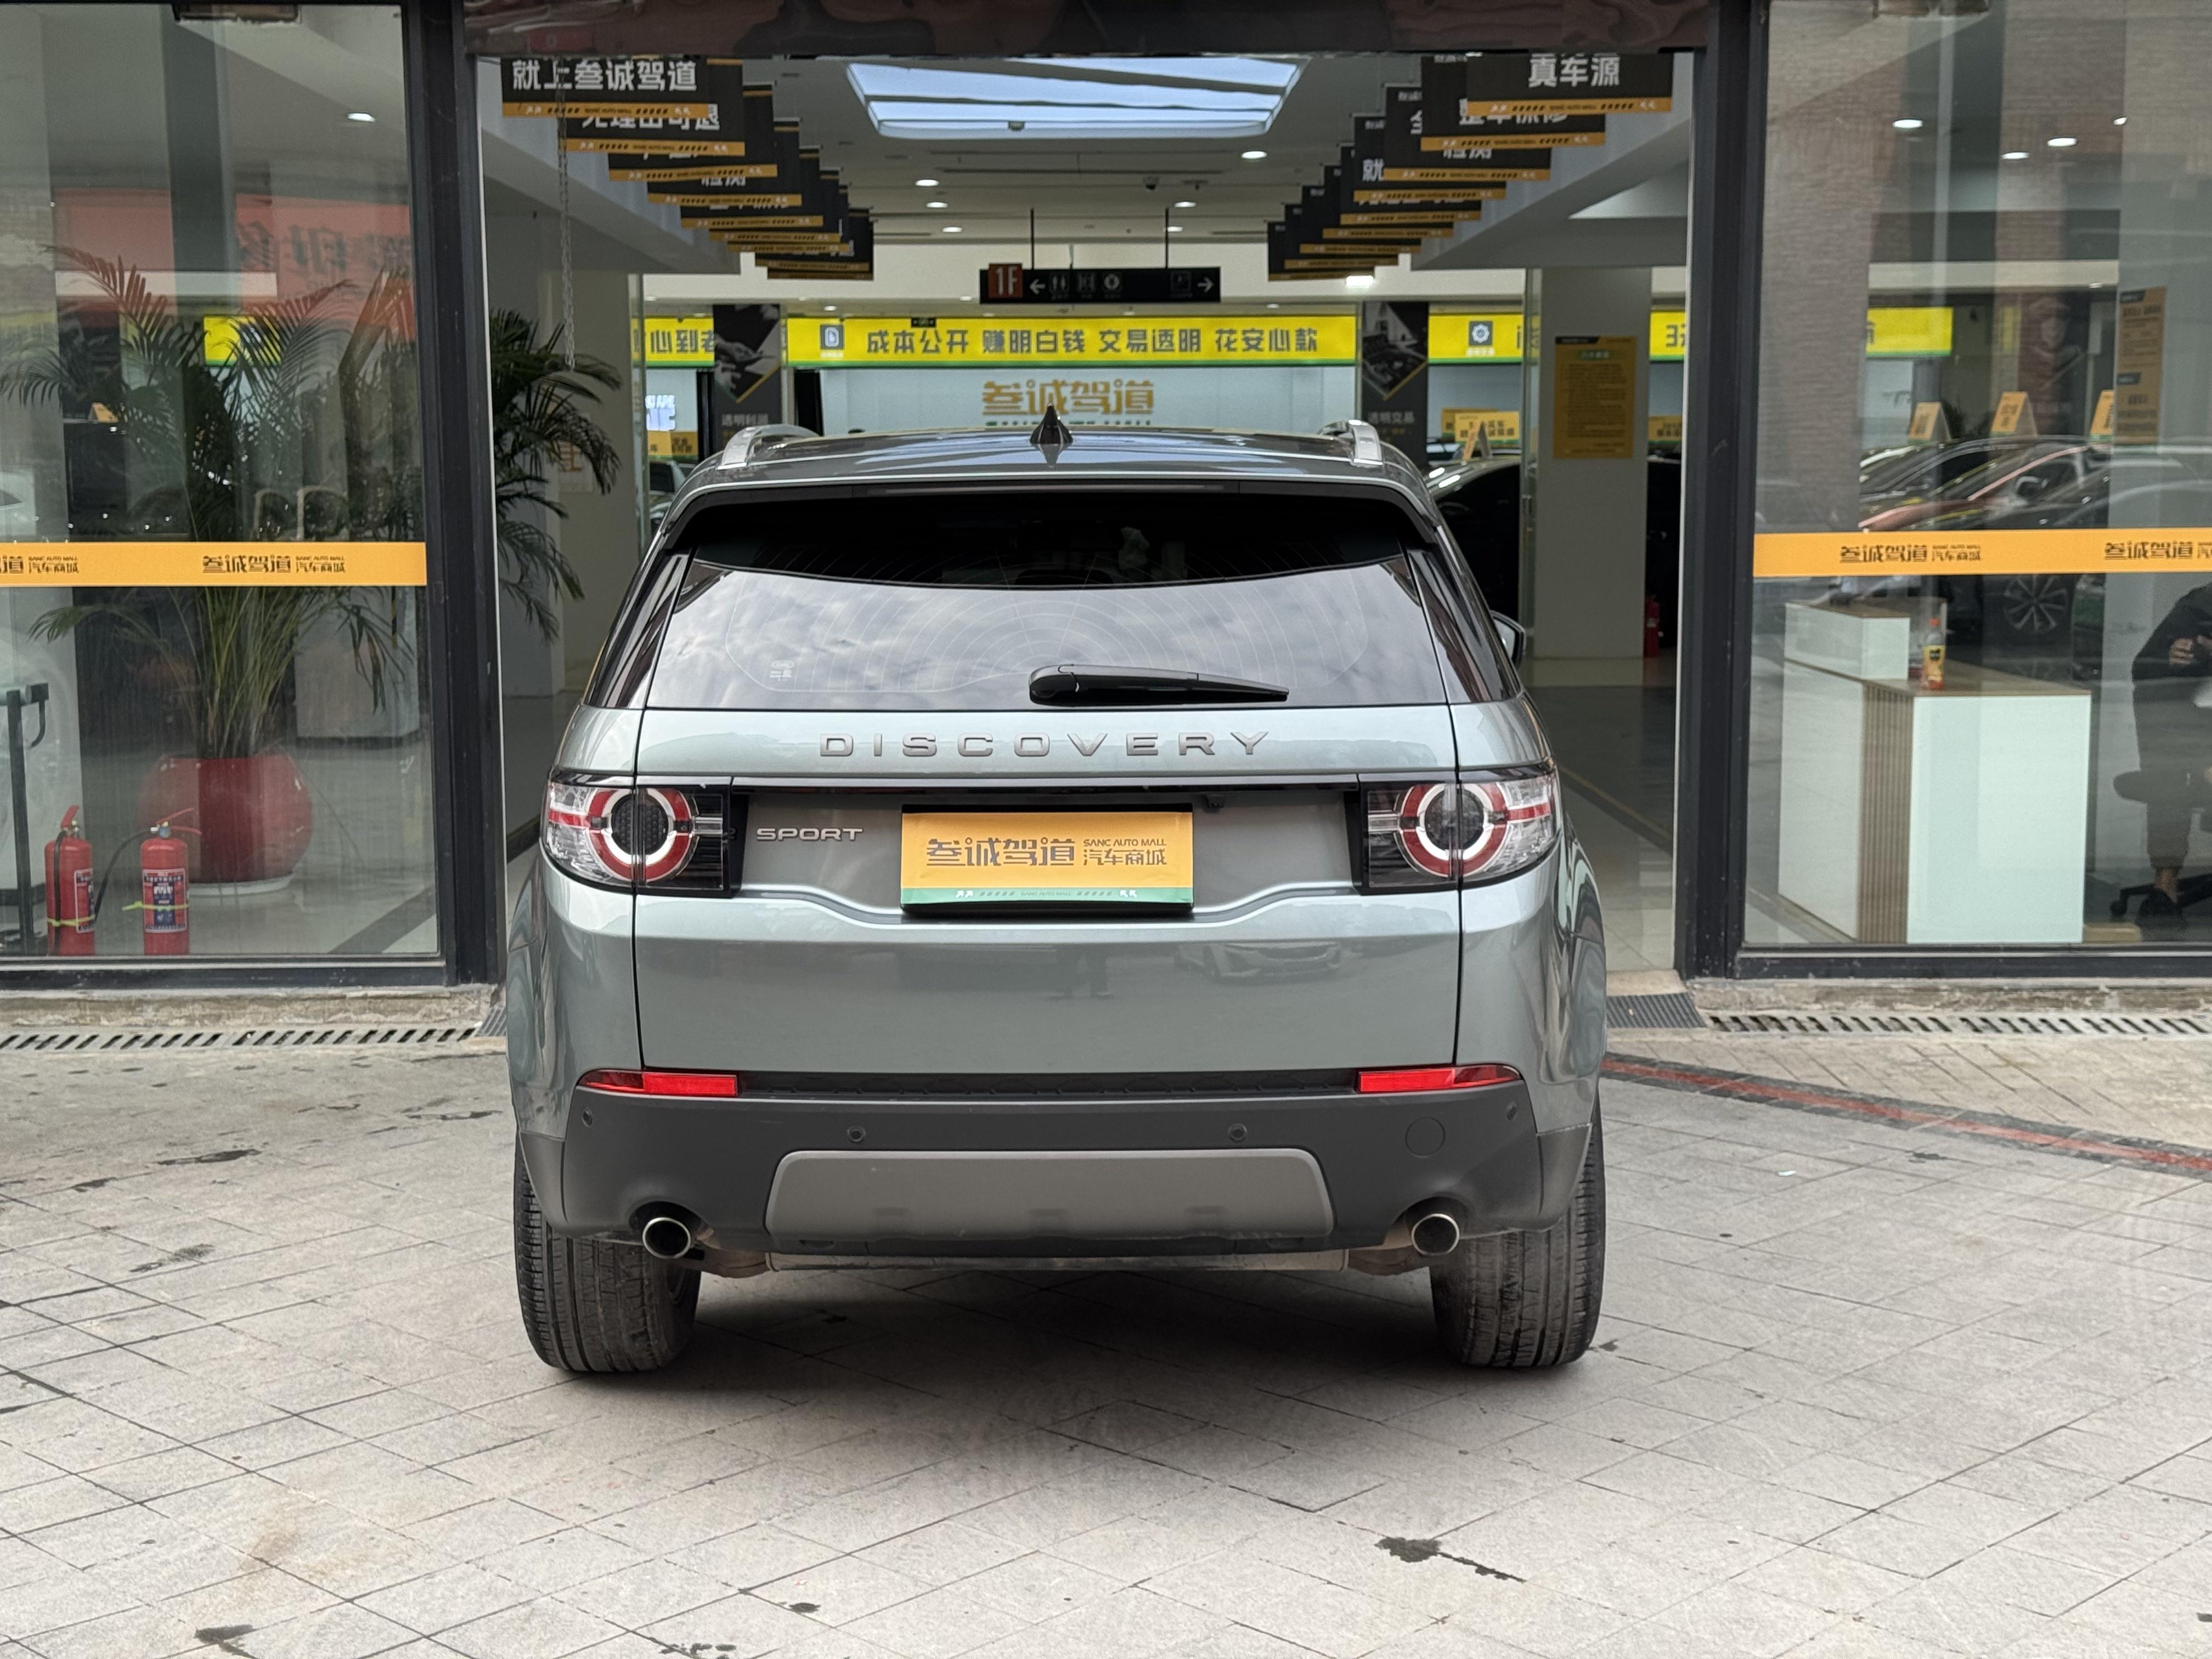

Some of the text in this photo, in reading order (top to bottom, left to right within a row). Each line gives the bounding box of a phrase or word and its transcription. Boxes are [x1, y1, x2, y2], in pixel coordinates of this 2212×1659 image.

[1528, 57, 1620, 88] 真车源
[995, 267, 1018, 296] 1F
[867, 328, 1317, 354] 成本公开 赚明白钱 交易透明 花安心款
[820, 731, 1269, 758] DISCOVERY
[756, 827, 864, 842] SPORT
[1083, 838, 1167, 847] SANC AUTO MALL
[927, 837, 1075, 866] 叁诚驾道
[1083, 848, 1167, 866] 汽车商城
